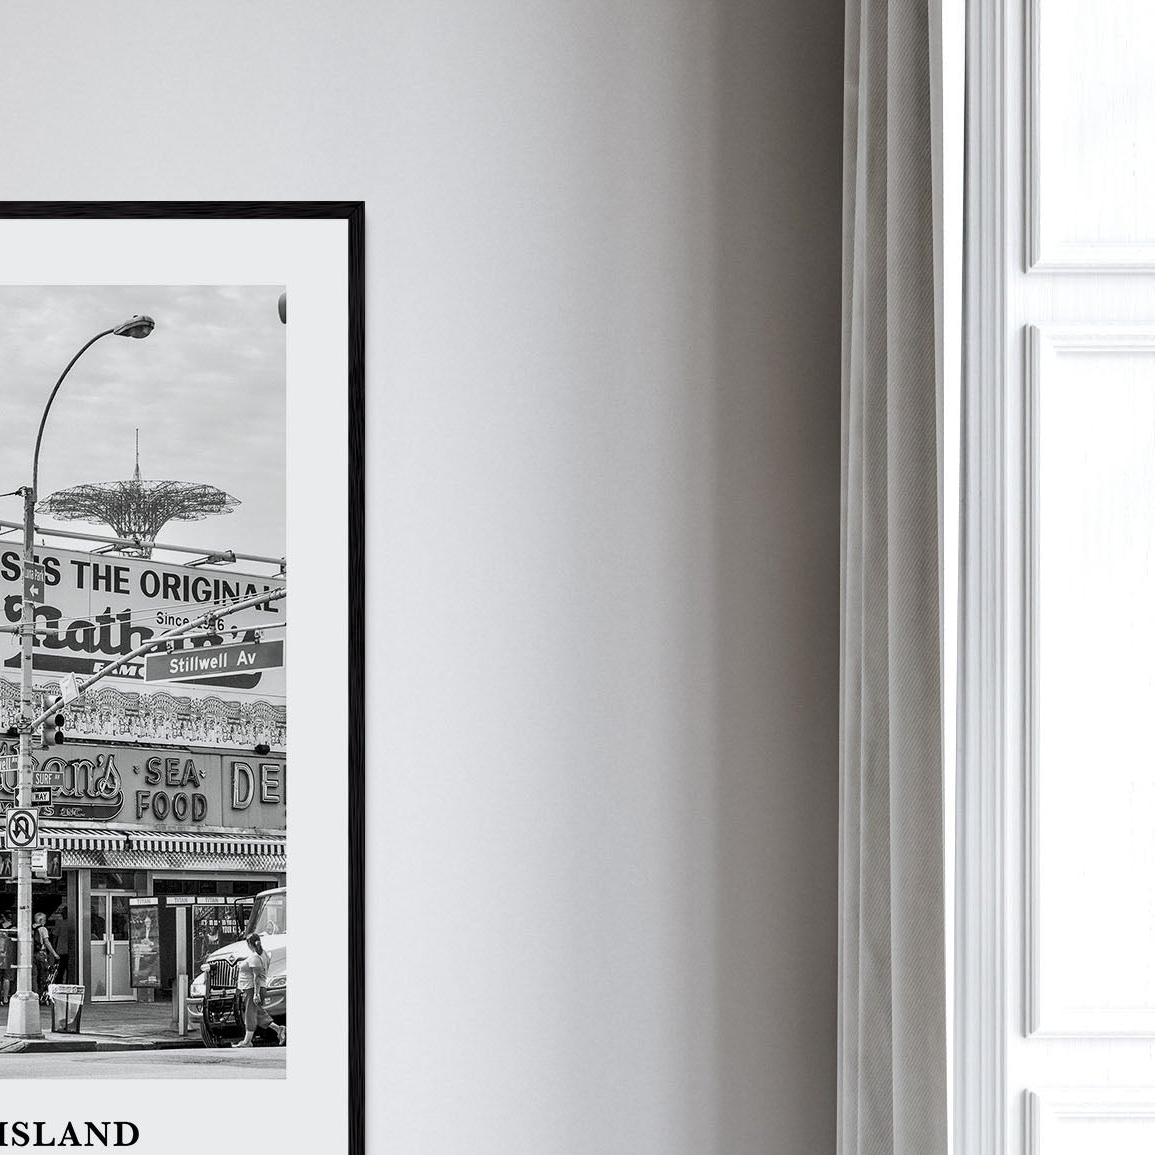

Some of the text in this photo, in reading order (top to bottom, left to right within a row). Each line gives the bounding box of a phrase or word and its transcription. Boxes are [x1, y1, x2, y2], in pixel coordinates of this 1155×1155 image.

[33, 555, 61, 586] S
[70, 560, 130, 595] THE
[140, 570, 279, 613] ORIGINAL
[156, 611, 189, 627] Since
[169, 650, 257, 674] Stillwell Av
[35, 773, 53, 785] SURF
[145, 756, 201, 788] SEA
[231, 761, 286, 811] DE
[135, 790, 208, 822] FOOD
